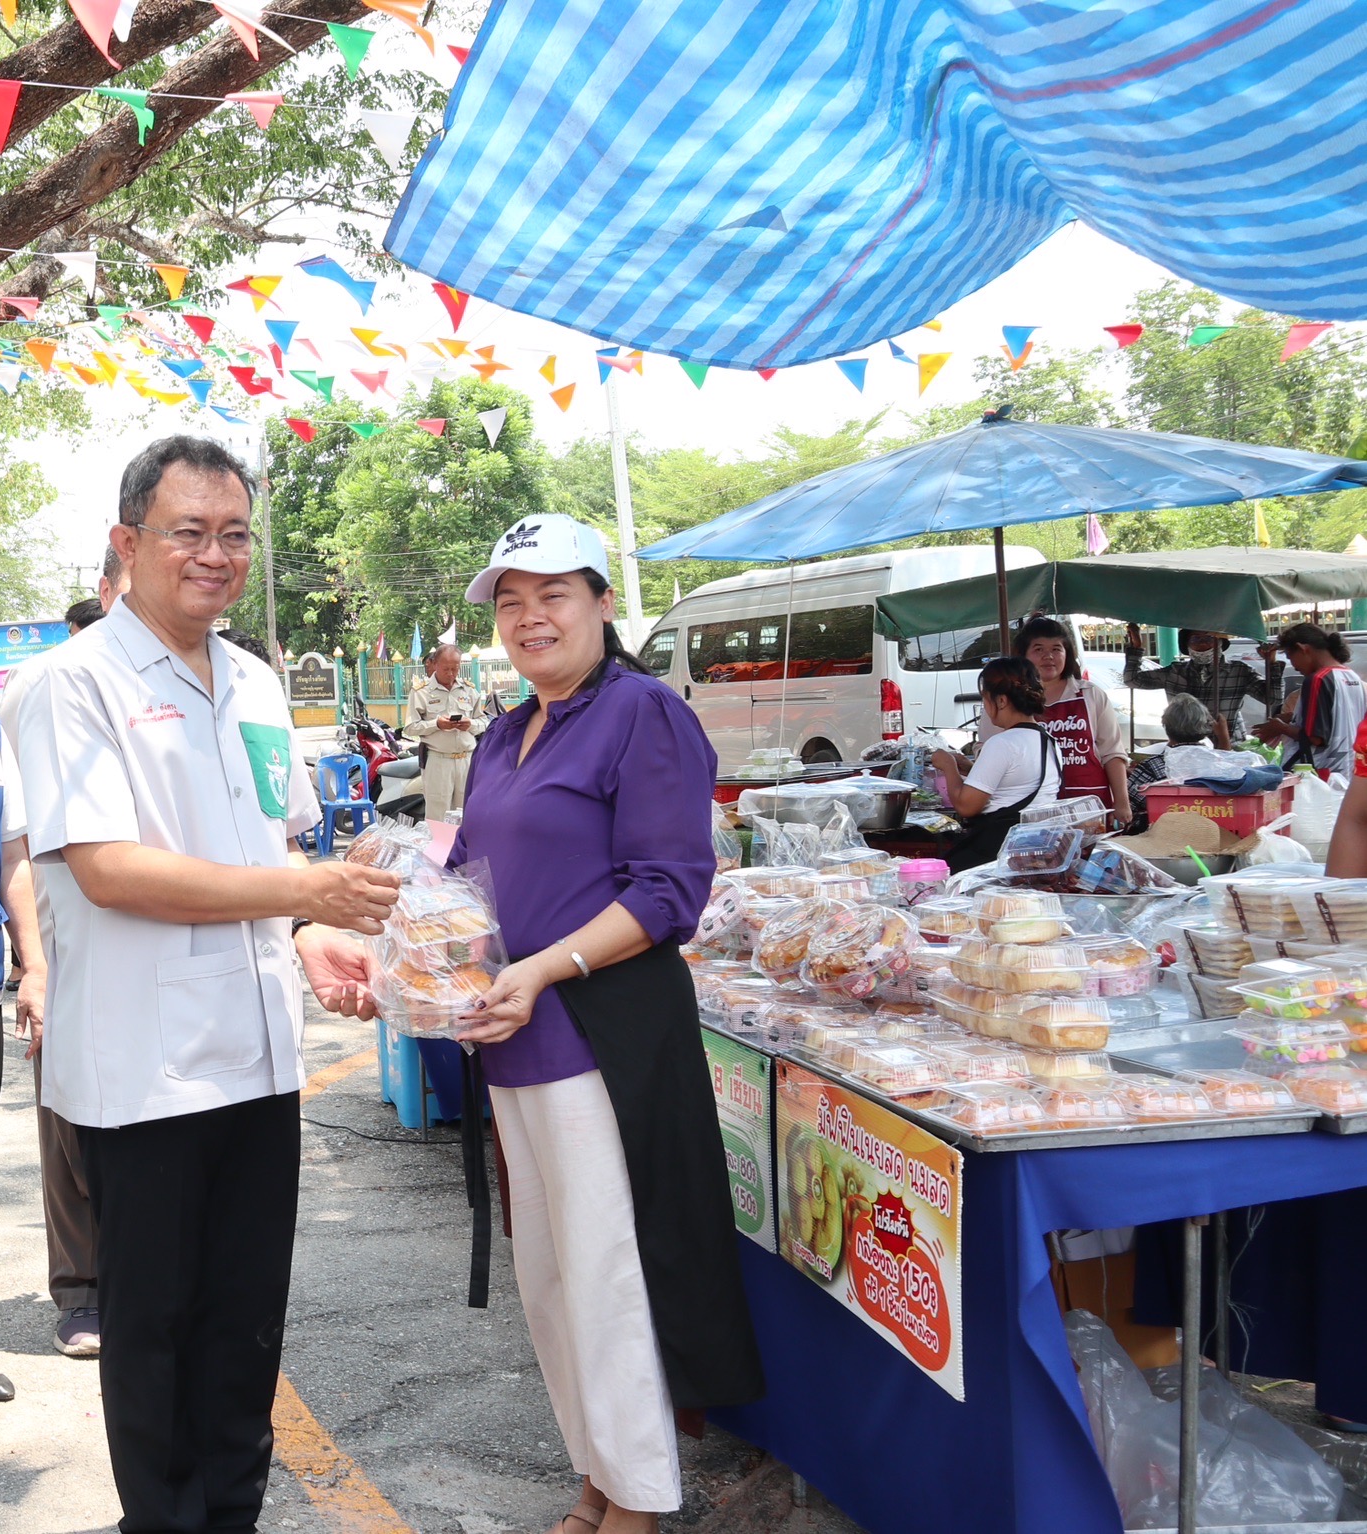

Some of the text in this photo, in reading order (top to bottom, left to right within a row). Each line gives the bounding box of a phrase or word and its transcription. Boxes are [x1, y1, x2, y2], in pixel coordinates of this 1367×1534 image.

[501, 540, 538, 557] adidas
[817, 1094, 904, 1188] มัฟฟินเนยสด
[907, 1157, 951, 1218] นมสด
[873, 1204, 910, 1239] โปรโมชั่น
[855, 1229, 938, 1318] กล่องละ 150฿
[864, 1272, 878, 1304] ฟรี
[879, 1286, 887, 1313] 1
